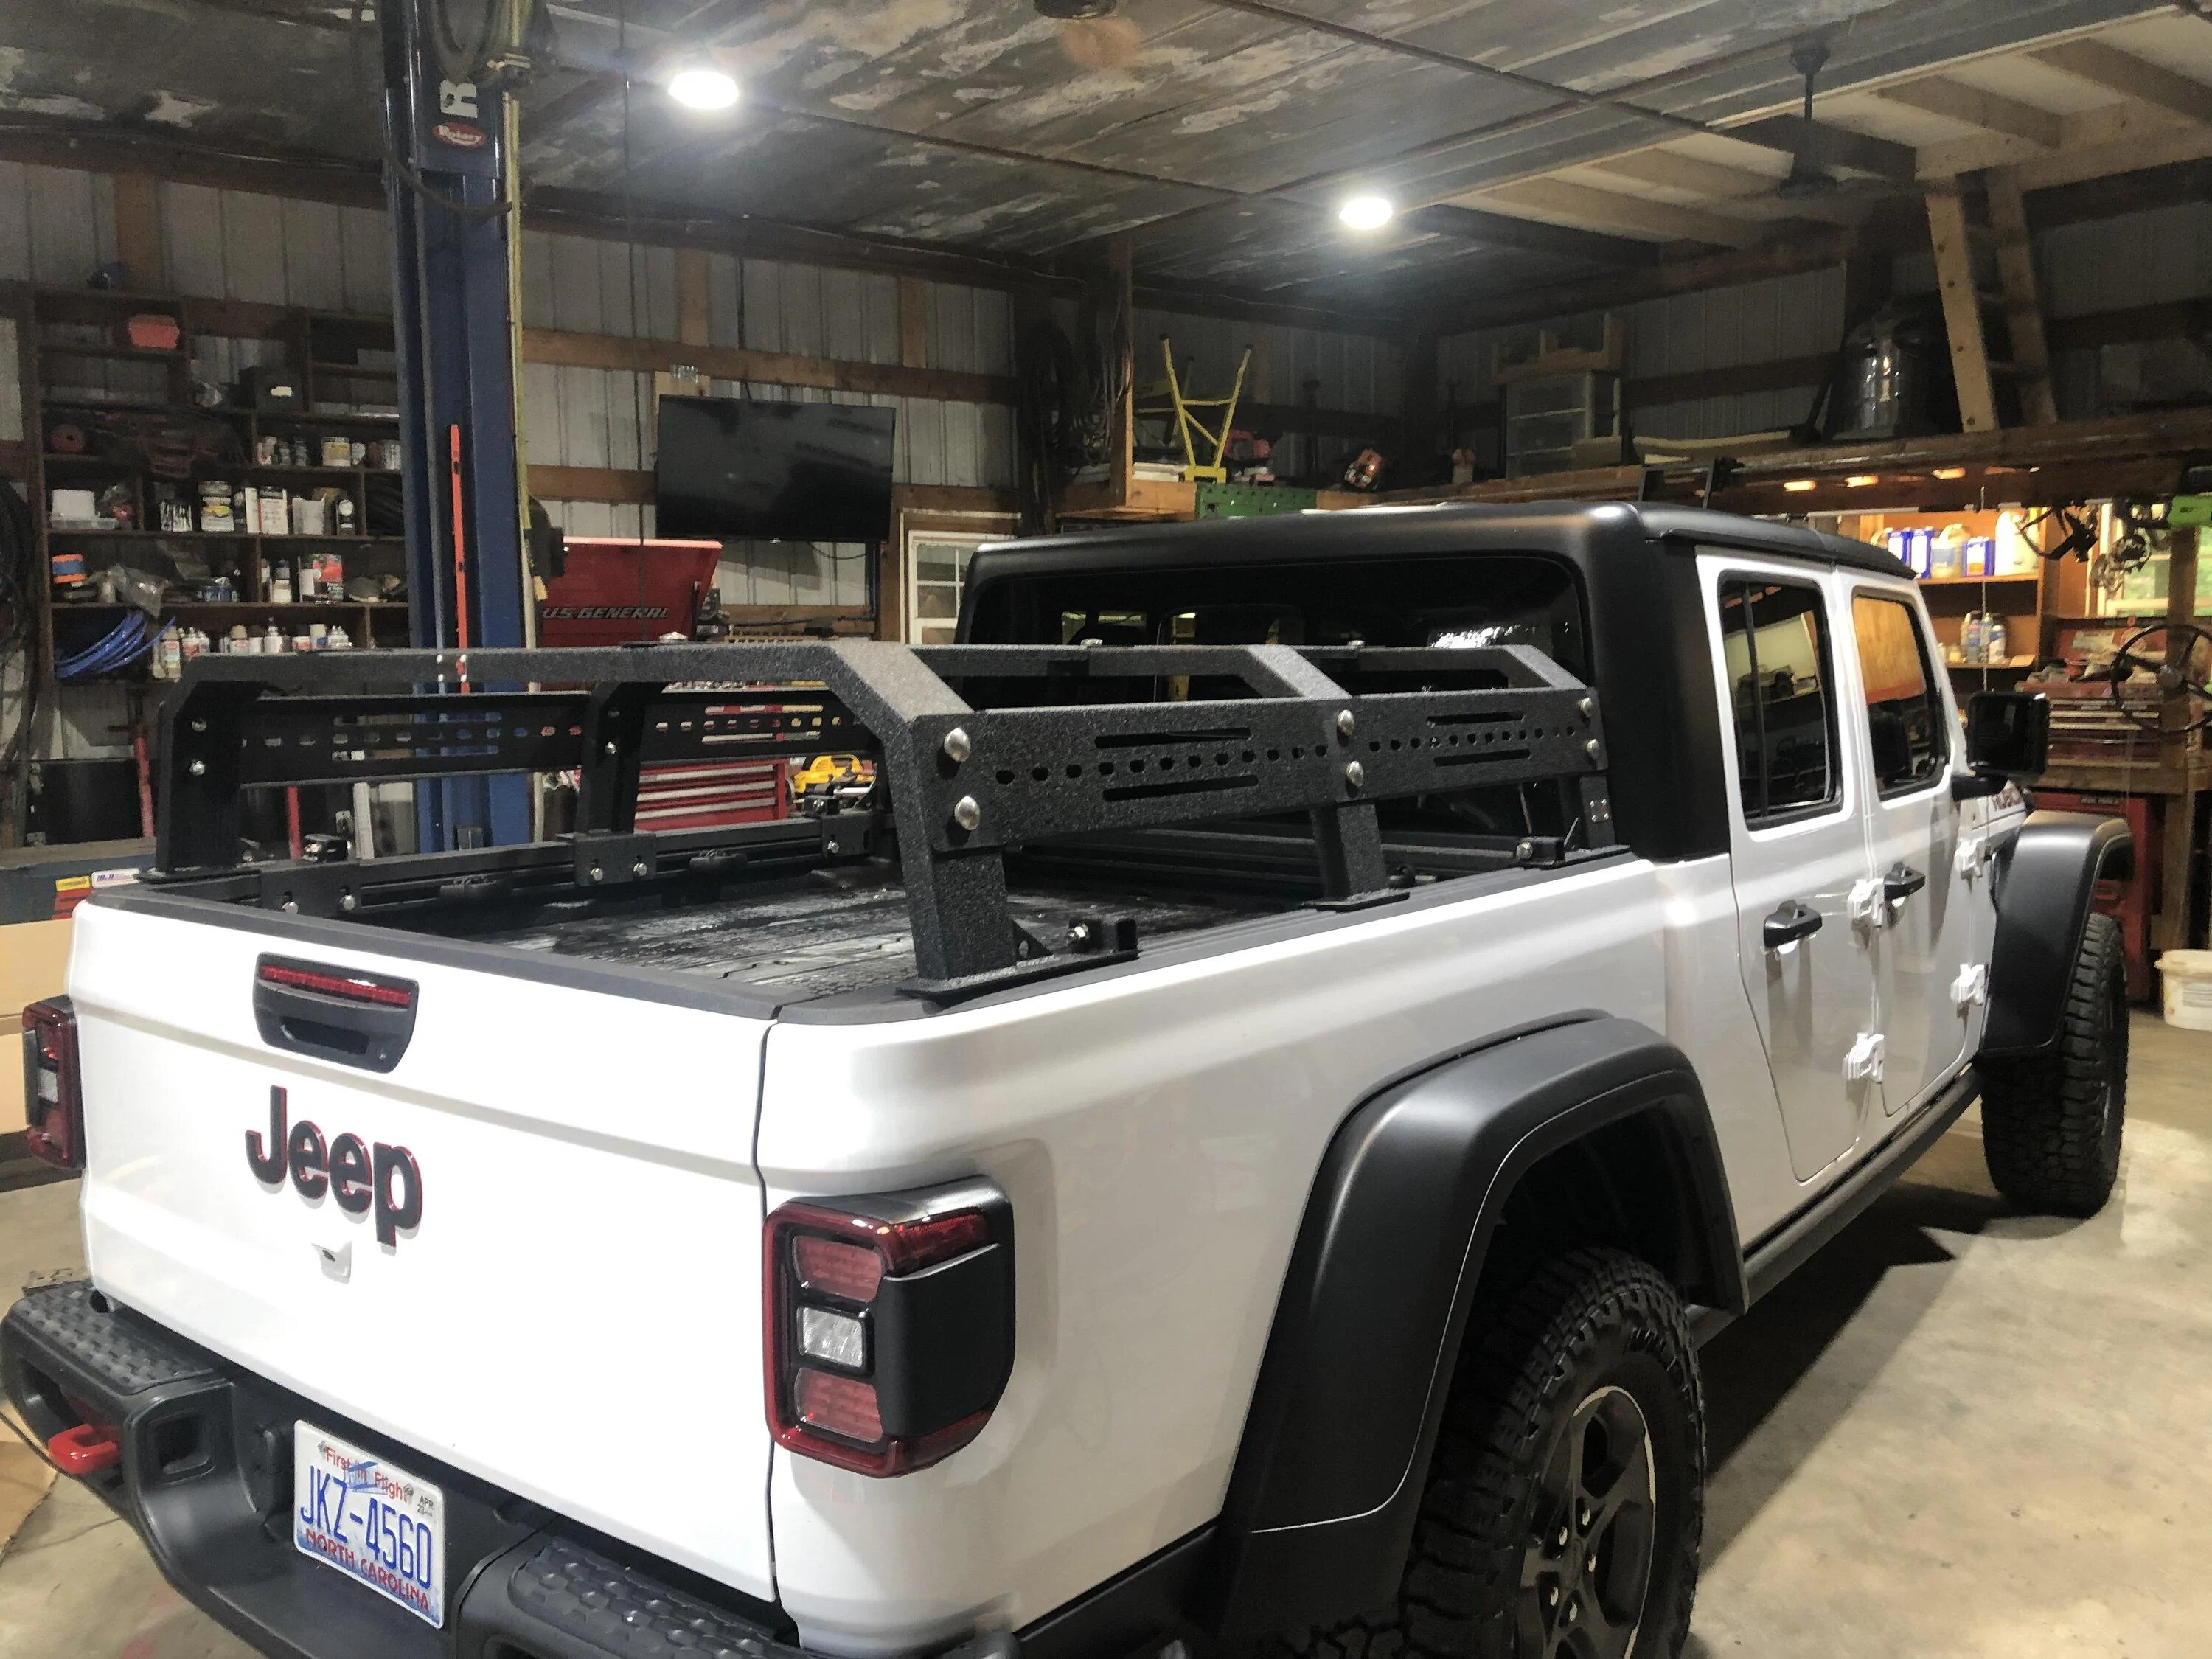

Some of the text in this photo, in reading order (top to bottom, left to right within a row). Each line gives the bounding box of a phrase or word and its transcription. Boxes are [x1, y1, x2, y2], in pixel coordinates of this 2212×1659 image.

[245, 1085, 423, 1248] Jeep
[325, 1447, 351, 1471] First
[300, 1465, 432, 1590] JKZ-4560
[305, 1528, 429, 1611] NORTH CAROLINA
